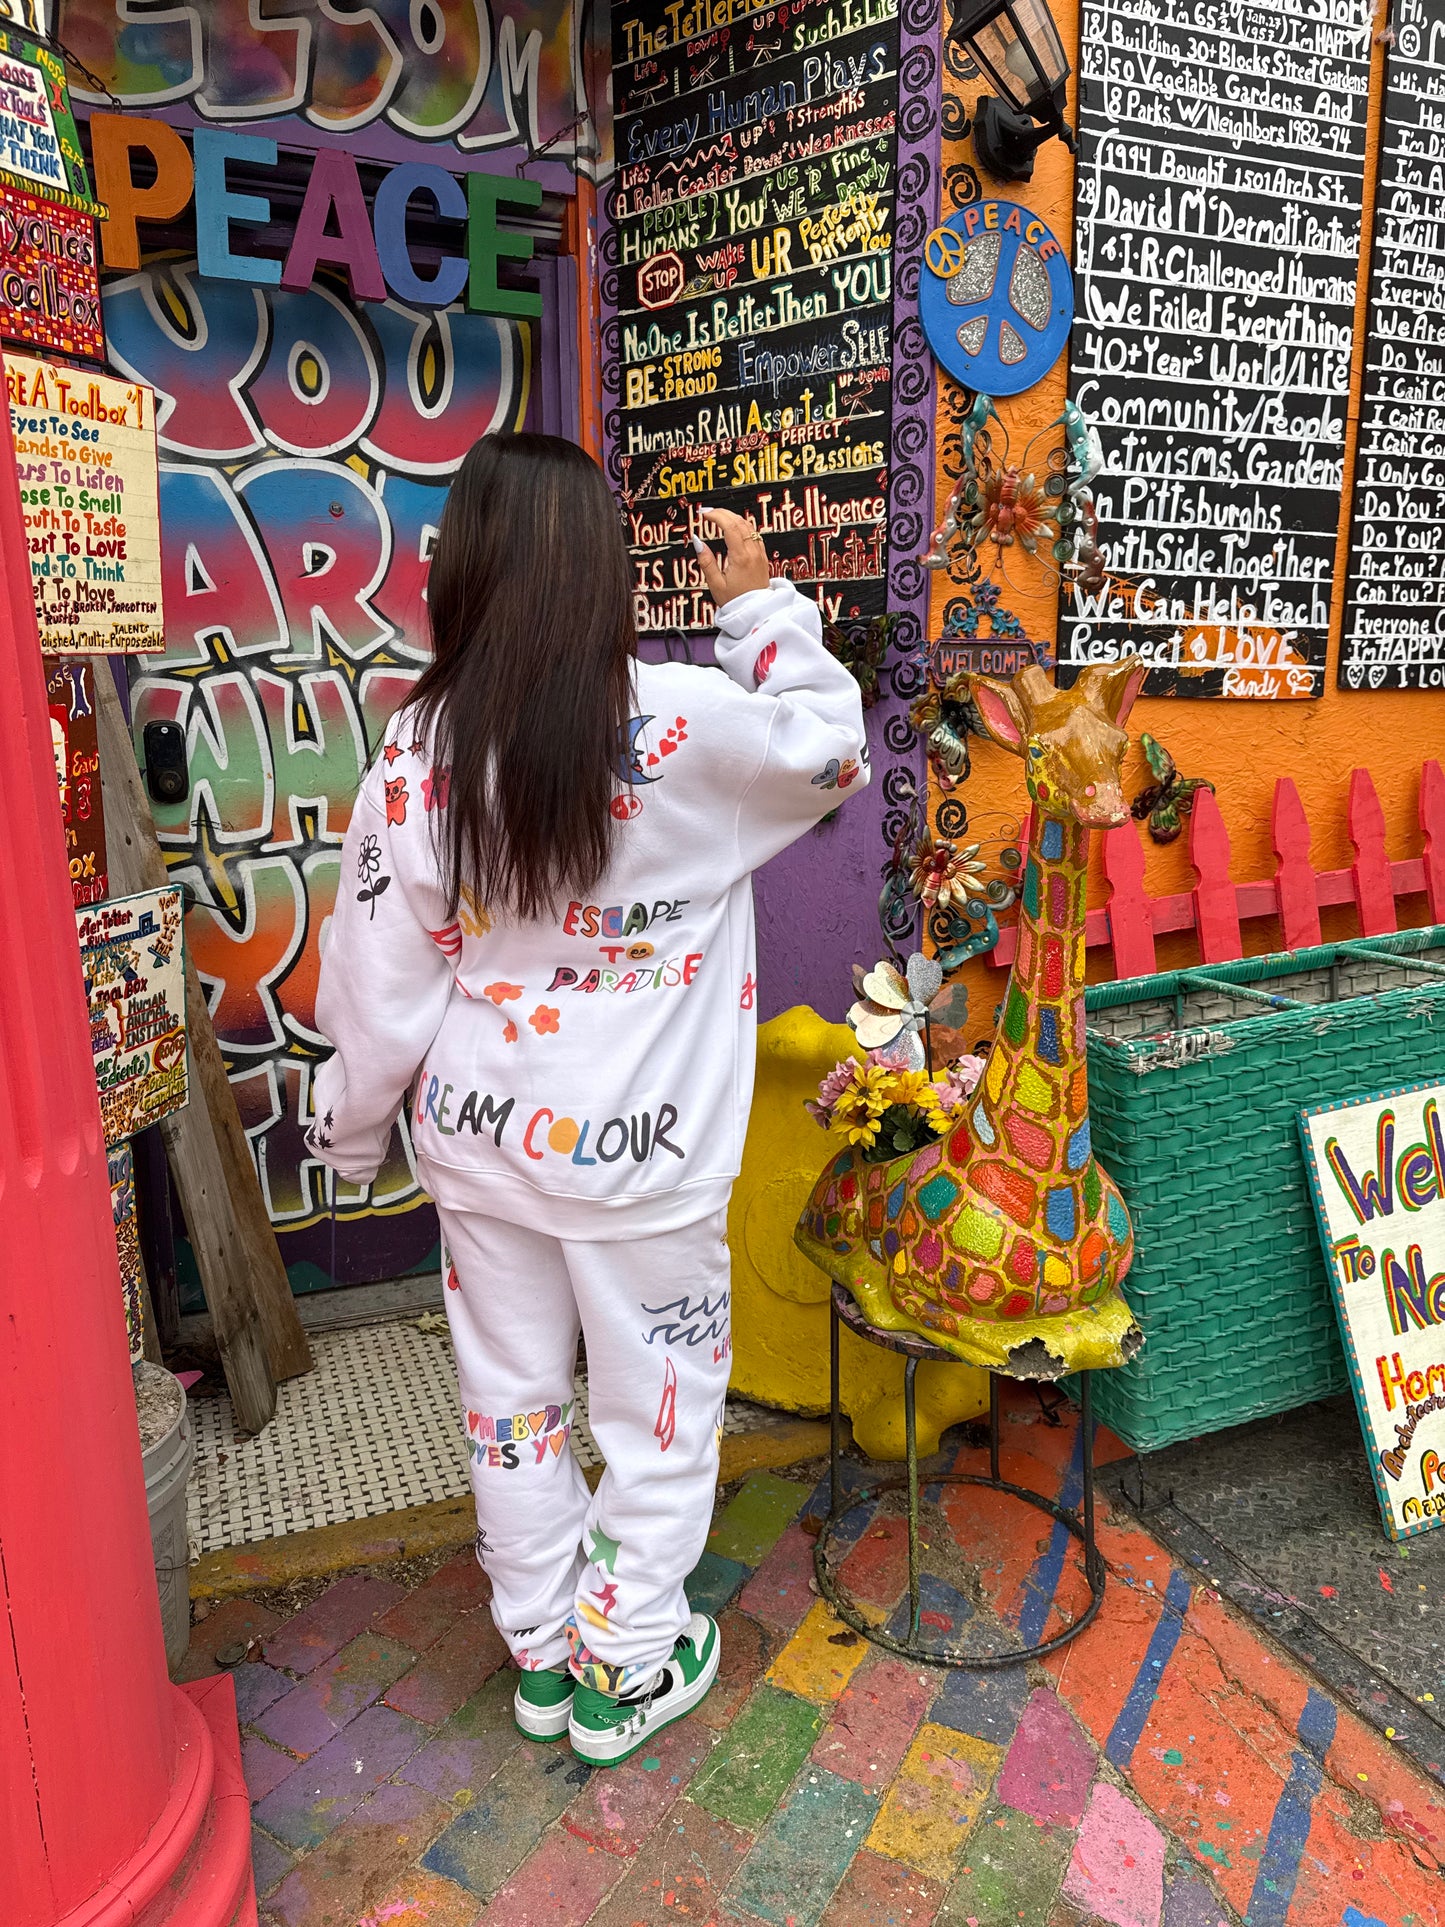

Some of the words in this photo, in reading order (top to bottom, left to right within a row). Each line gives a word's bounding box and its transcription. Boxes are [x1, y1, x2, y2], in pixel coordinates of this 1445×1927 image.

[794, 8, 841, 51] Such
[1084, 12, 1100, 37] 18
[1112, 20, 1180, 68] Building
[1188, 37, 1217, 62] 30+
[1219, 41, 1270, 74] Blocks
[1272, 50, 1319, 82] Street
[1319, 58, 1368, 92] Gardens
[628, 112, 699, 165] Every
[707, 81, 797, 134] Human
[803, 43, 891, 101] Plays
[1109, 57, 1135, 81] 50
[1225, 75, 1303, 111] Gardens
[1313, 82, 1353, 121] And
[1108, 88, 1122, 116] 8
[1126, 89, 1172, 125] Parks
[1288, 119, 1352, 152] 1982-94
[9, 140, 61, 180] THINK
[831, 148, 871, 179] Fine
[1105, 141, 1150, 169] 1994
[1161, 150, 1227, 194] Bought
[1235, 168, 1272, 190] 1501
[1272, 168, 1313, 198] Arch
[633, 183, 674, 213] Roller
[1077, 178, 1095, 204] 28
[1104, 185, 1172, 230] David
[90, 112, 544, 318] PEACE
[643, 192, 708, 235] PEOPLE
[799, 191, 880, 250] Perfectly
[964, 203, 1060, 261] PEACE
[645, 266, 677, 292] STOP
[712, 295, 774, 343] Better
[771, 282, 827, 325] Then
[831, 254, 892, 310] YOU
[713, 268, 738, 290] UP
[1288, 258, 1357, 306] Humans
[1091, 284, 1142, 325] We
[1149, 288, 1212, 332] Failed
[1221, 295, 1353, 364] Everything
[664, 347, 722, 377] STRONG
[1382, 344, 1407, 369] Do
[665, 371, 717, 399] PROUD
[49, 416, 68, 436] To
[71, 421, 100, 442] See
[627, 421, 695, 455] Humans
[746, 380, 837, 433] Assorted
[59, 441, 76, 461] To
[80, 445, 113, 468] Give
[658, 456, 716, 499] Smart
[731, 443, 794, 487] Skills
[802, 436, 885, 474] Passions
[1247, 440, 1344, 486] Gardens
[50, 461, 71, 485] To
[76, 465, 124, 493] Listen
[1379, 462, 1418, 491] Only
[54, 486, 75, 508] To
[79, 493, 122, 514] Smell
[756, 485, 886, 537] Intelligence
[1123, 477, 1282, 547] Pittsburghs
[1364, 491, 1390, 518] Do
[62, 510, 80, 533] To
[84, 512, 127, 538] Taste
[1362, 524, 1387, 547] Do
[62, 533, 81, 556] To
[57, 555, 77, 578] To
[82, 557, 125, 582] Think
[1360, 553, 1390, 577] Are
[53, 578, 72, 600] To
[76, 580, 116, 602] Move
[1134, 578, 1184, 621] Can
[1195, 581, 1258, 639] Help
[1261, 583, 1328, 624] Teach
[1356, 581, 1387, 604] Can
[634, 593, 689, 632] Built
[1354, 608, 1429, 635] Everyone
[938, 649, 1029, 674] WELCOME
[1215, 625, 1298, 665] LOVE
[562, 900, 690, 938] ESCAPE
[415, 1071, 515, 1148] CREAM
[523, 1103, 685, 1166] COLOUR
[1333, 1234, 1376, 1284] To
